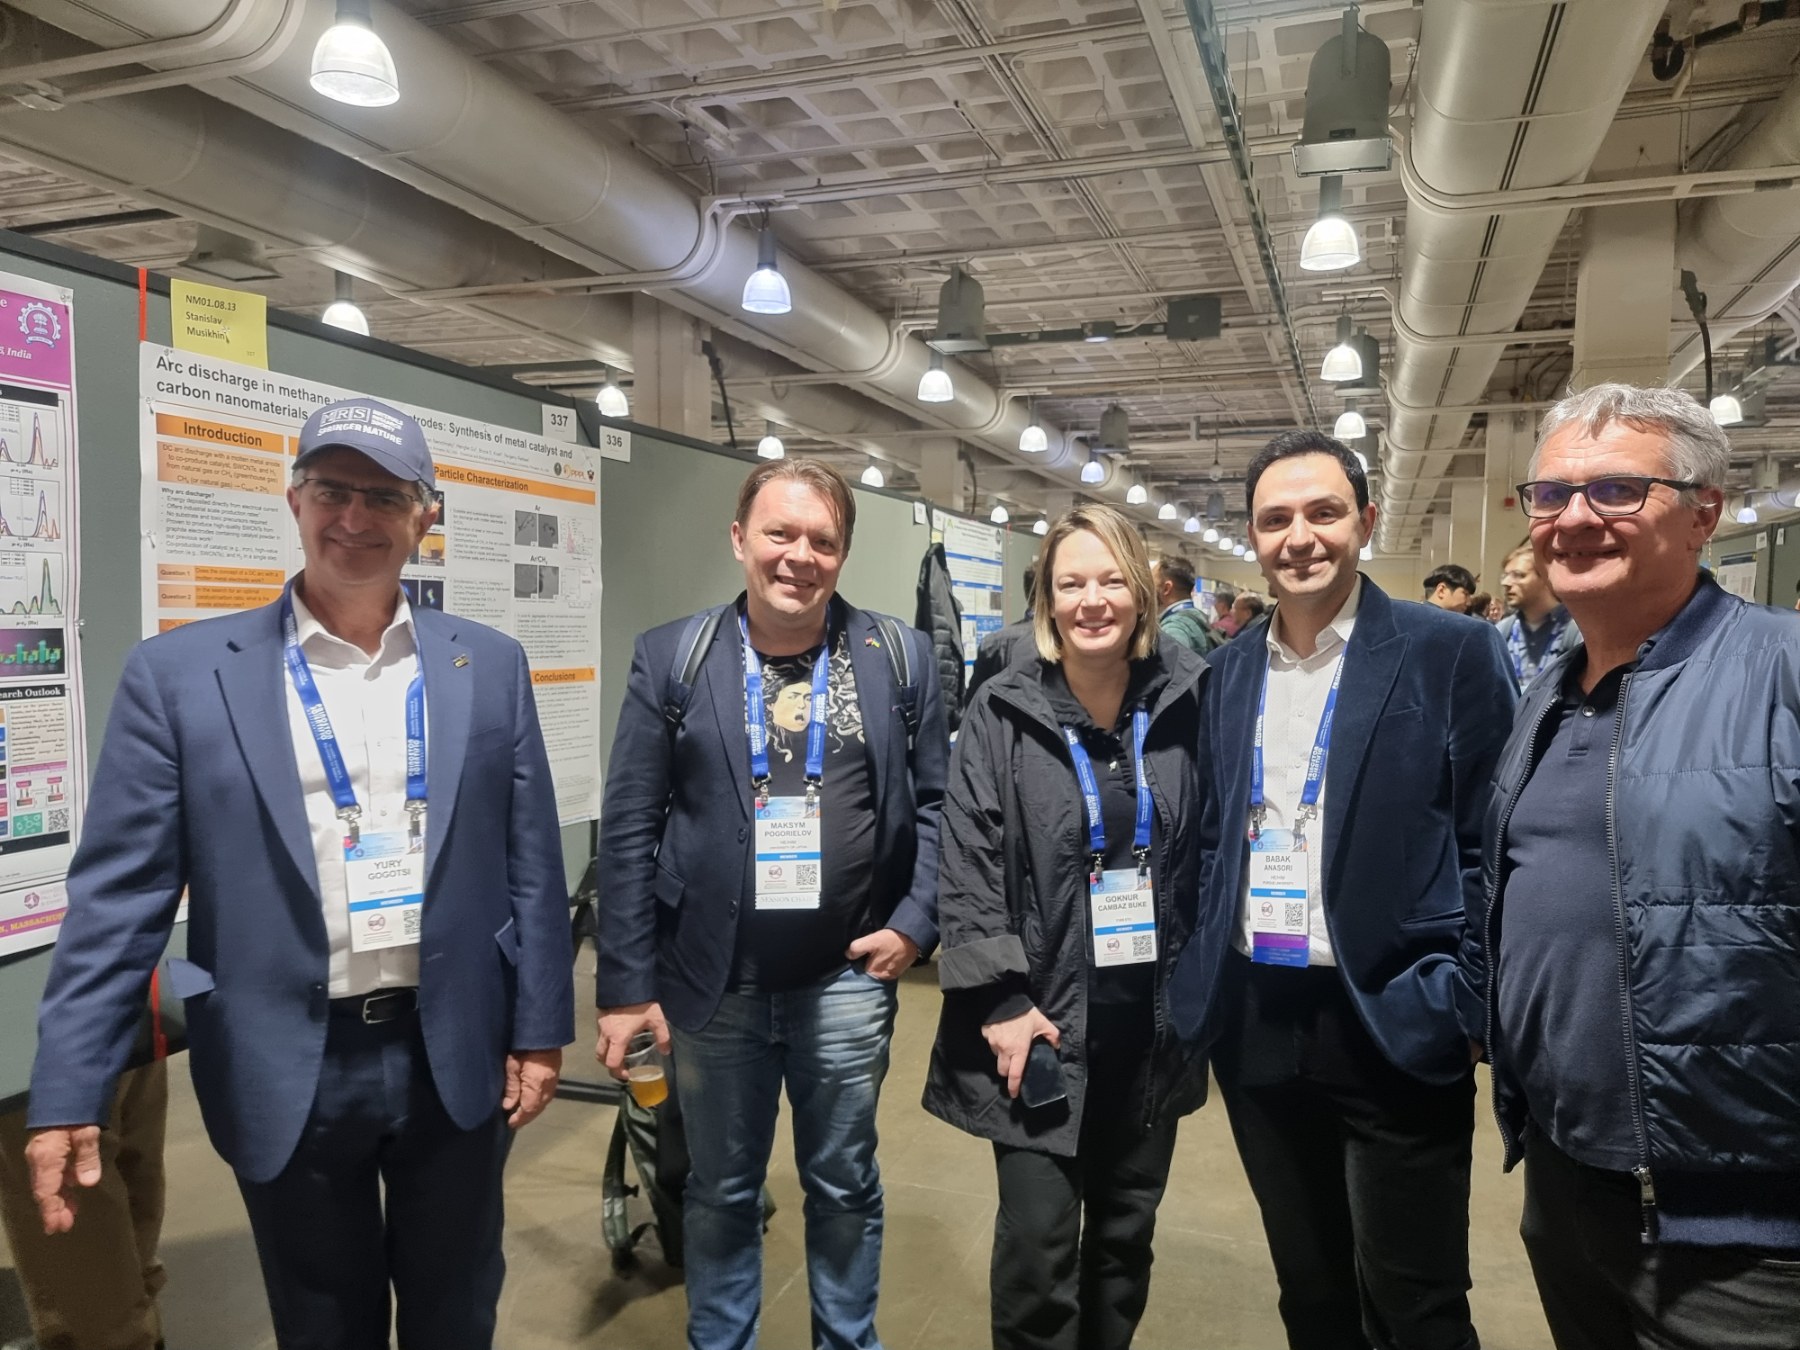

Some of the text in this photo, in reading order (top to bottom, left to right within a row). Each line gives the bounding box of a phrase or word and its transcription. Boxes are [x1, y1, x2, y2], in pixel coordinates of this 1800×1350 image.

[186, 295, 236, 311] NM01.08.13
[186, 312, 222, 325] Stanislav
[187, 326, 225, 340] Musikhin
[7, 347, 32, 360] India
[156, 380, 308, 421] carbon nanomaterials
[156, 356, 183, 374] Arc
[188, 363, 258, 391] discharge
[262, 379, 275, 393] in
[279, 385, 330, 406] methane
[412, 414, 446, 431] trodes:
[449, 423, 492, 442] Synthesis
[494, 430, 503, 444] of
[505, 436, 527, 449] metal
[529, 441, 558, 457] catalyst
[559, 446, 573, 459] and
[321, 408, 368, 426] MRS
[550, 413, 568, 427] 337
[184, 421, 262, 447] Introduction
[317, 423, 402, 445] SPRINGER NATURE
[606, 434, 623, 448] 336
[434, 467, 529, 491] Particle Characterization
[535, 671, 576, 683] Conclusions
[0, 687, 61, 699] earch Outlook
[374, 859, 402, 870] YURY
[1266, 855, 1291, 863] BABAK
[368, 868, 411, 880] GOGOTSI
[1106, 894, 1138, 903] GOKNUR
[1098, 903, 1127, 911] CAMBAZ
